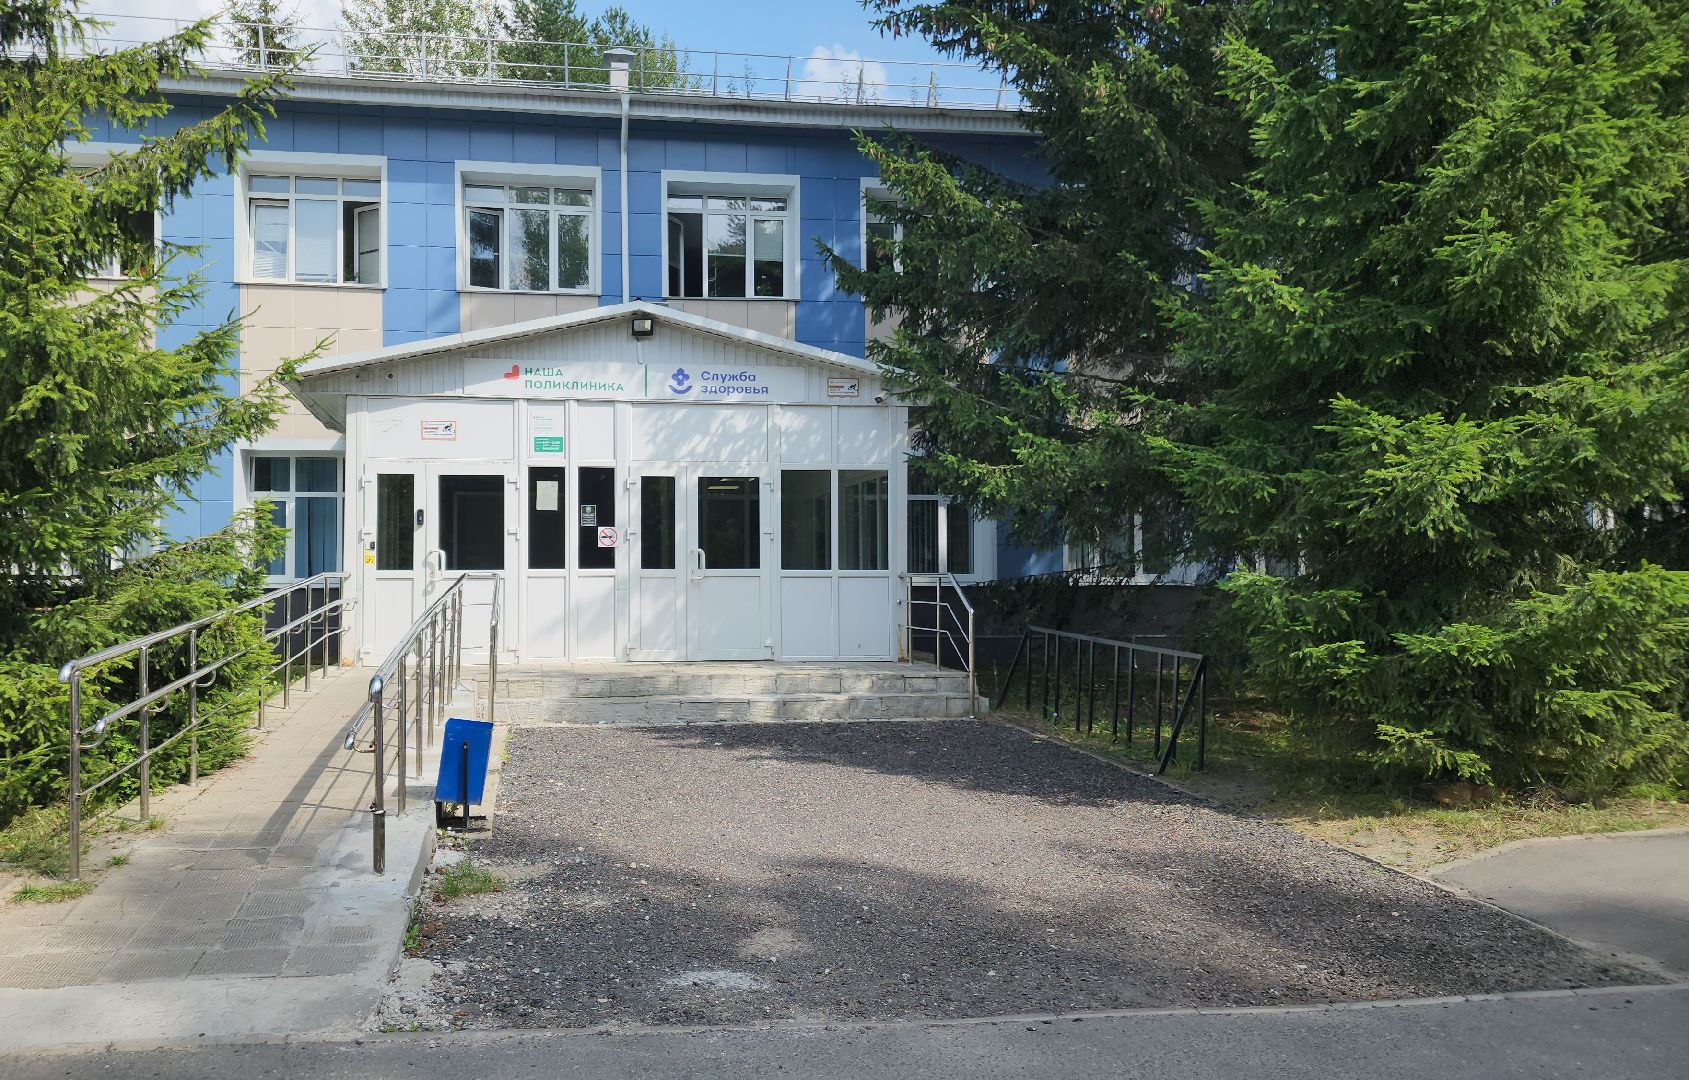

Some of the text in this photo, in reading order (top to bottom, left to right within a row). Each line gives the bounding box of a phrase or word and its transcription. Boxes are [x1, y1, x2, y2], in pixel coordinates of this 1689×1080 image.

[524, 367, 563, 377] НАША
[701, 371, 756, 383] Служба
[524, 380, 624, 392] ПОЛИКЛИНИКА
[701, 385, 769, 396] здоровья
